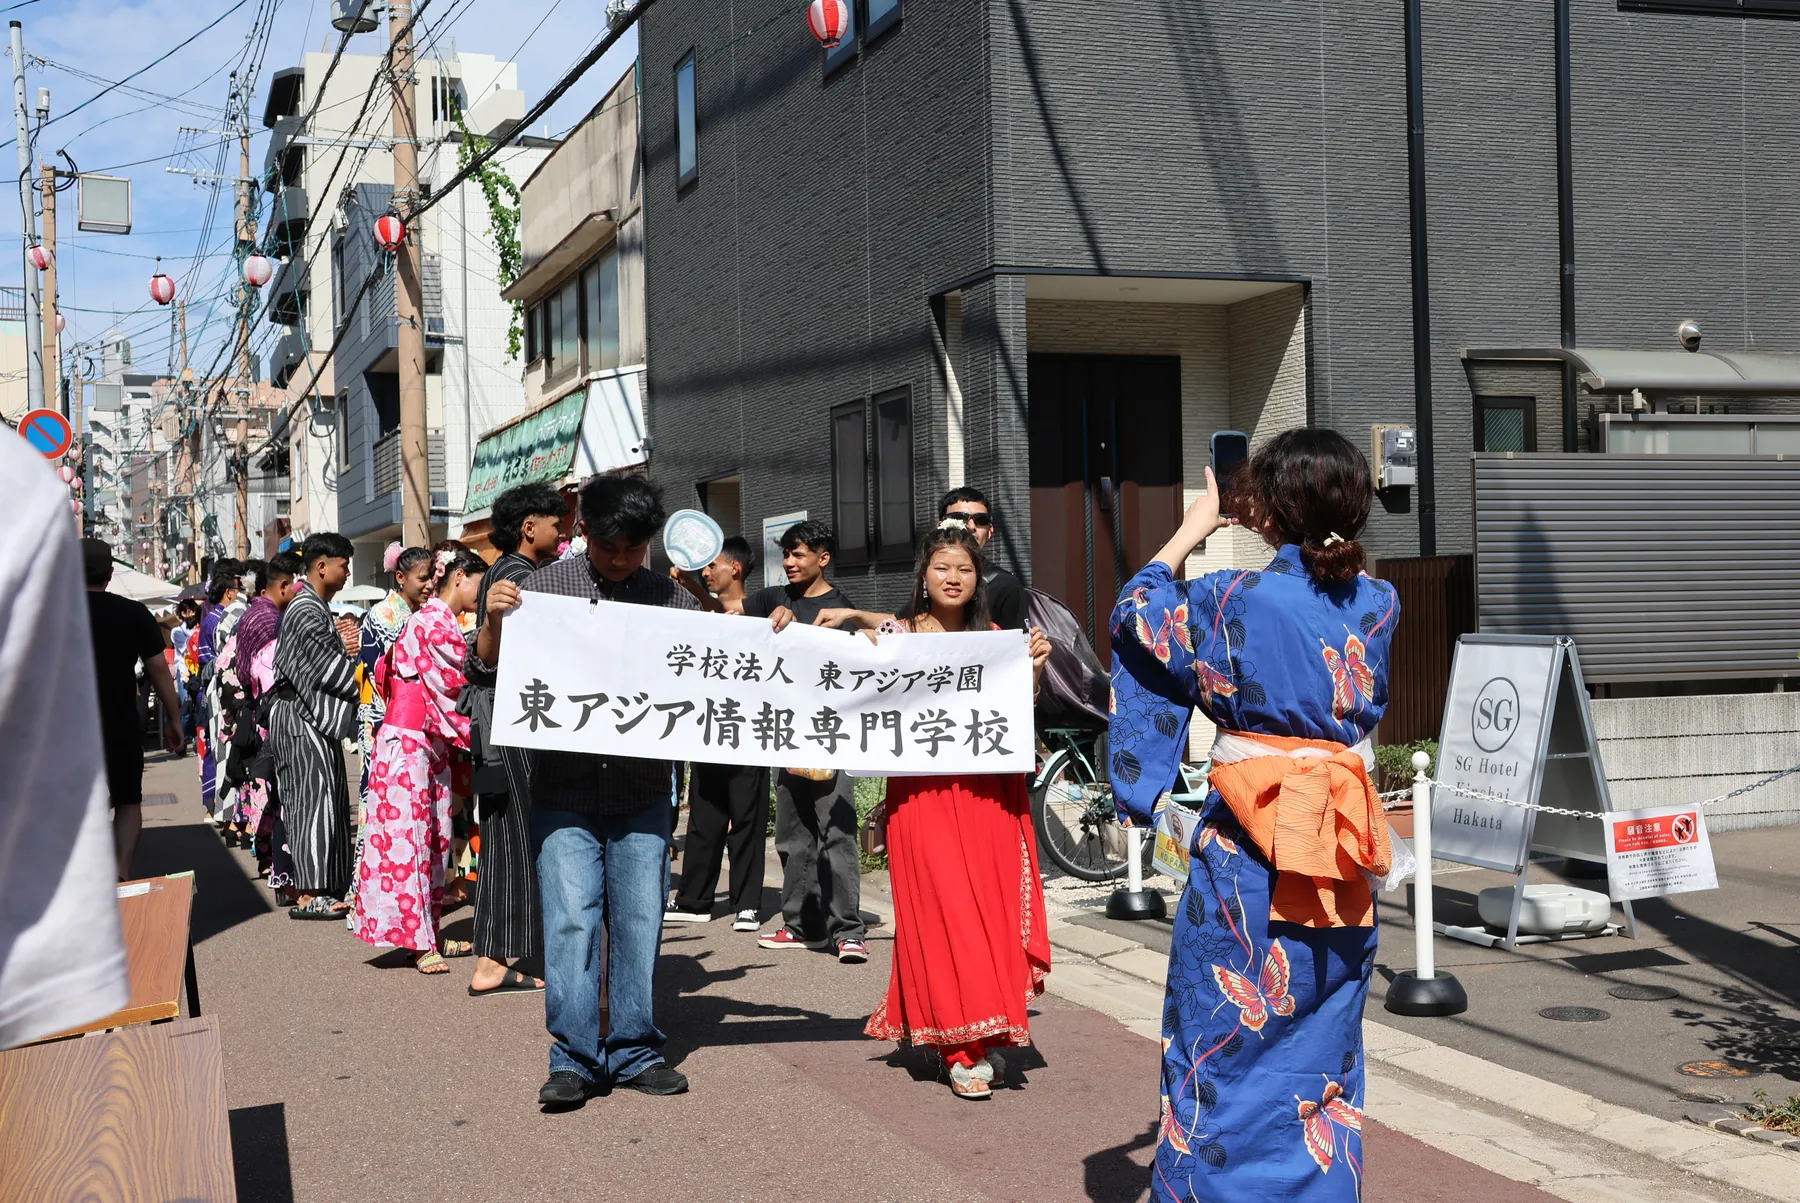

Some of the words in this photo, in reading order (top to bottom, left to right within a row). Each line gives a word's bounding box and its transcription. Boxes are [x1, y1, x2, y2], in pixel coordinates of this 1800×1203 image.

[666, 643, 794, 684] 学校法人
[814, 660, 984, 694] 東アジア学園
[511, 678, 1014, 758] 東アジア情報専門学校
[1477, 698, 1513, 732] SG
[1455, 755, 1473, 772] SG
[1479, 758, 1519, 777] Hotel
[1453, 808, 1503, 831] Hakata
